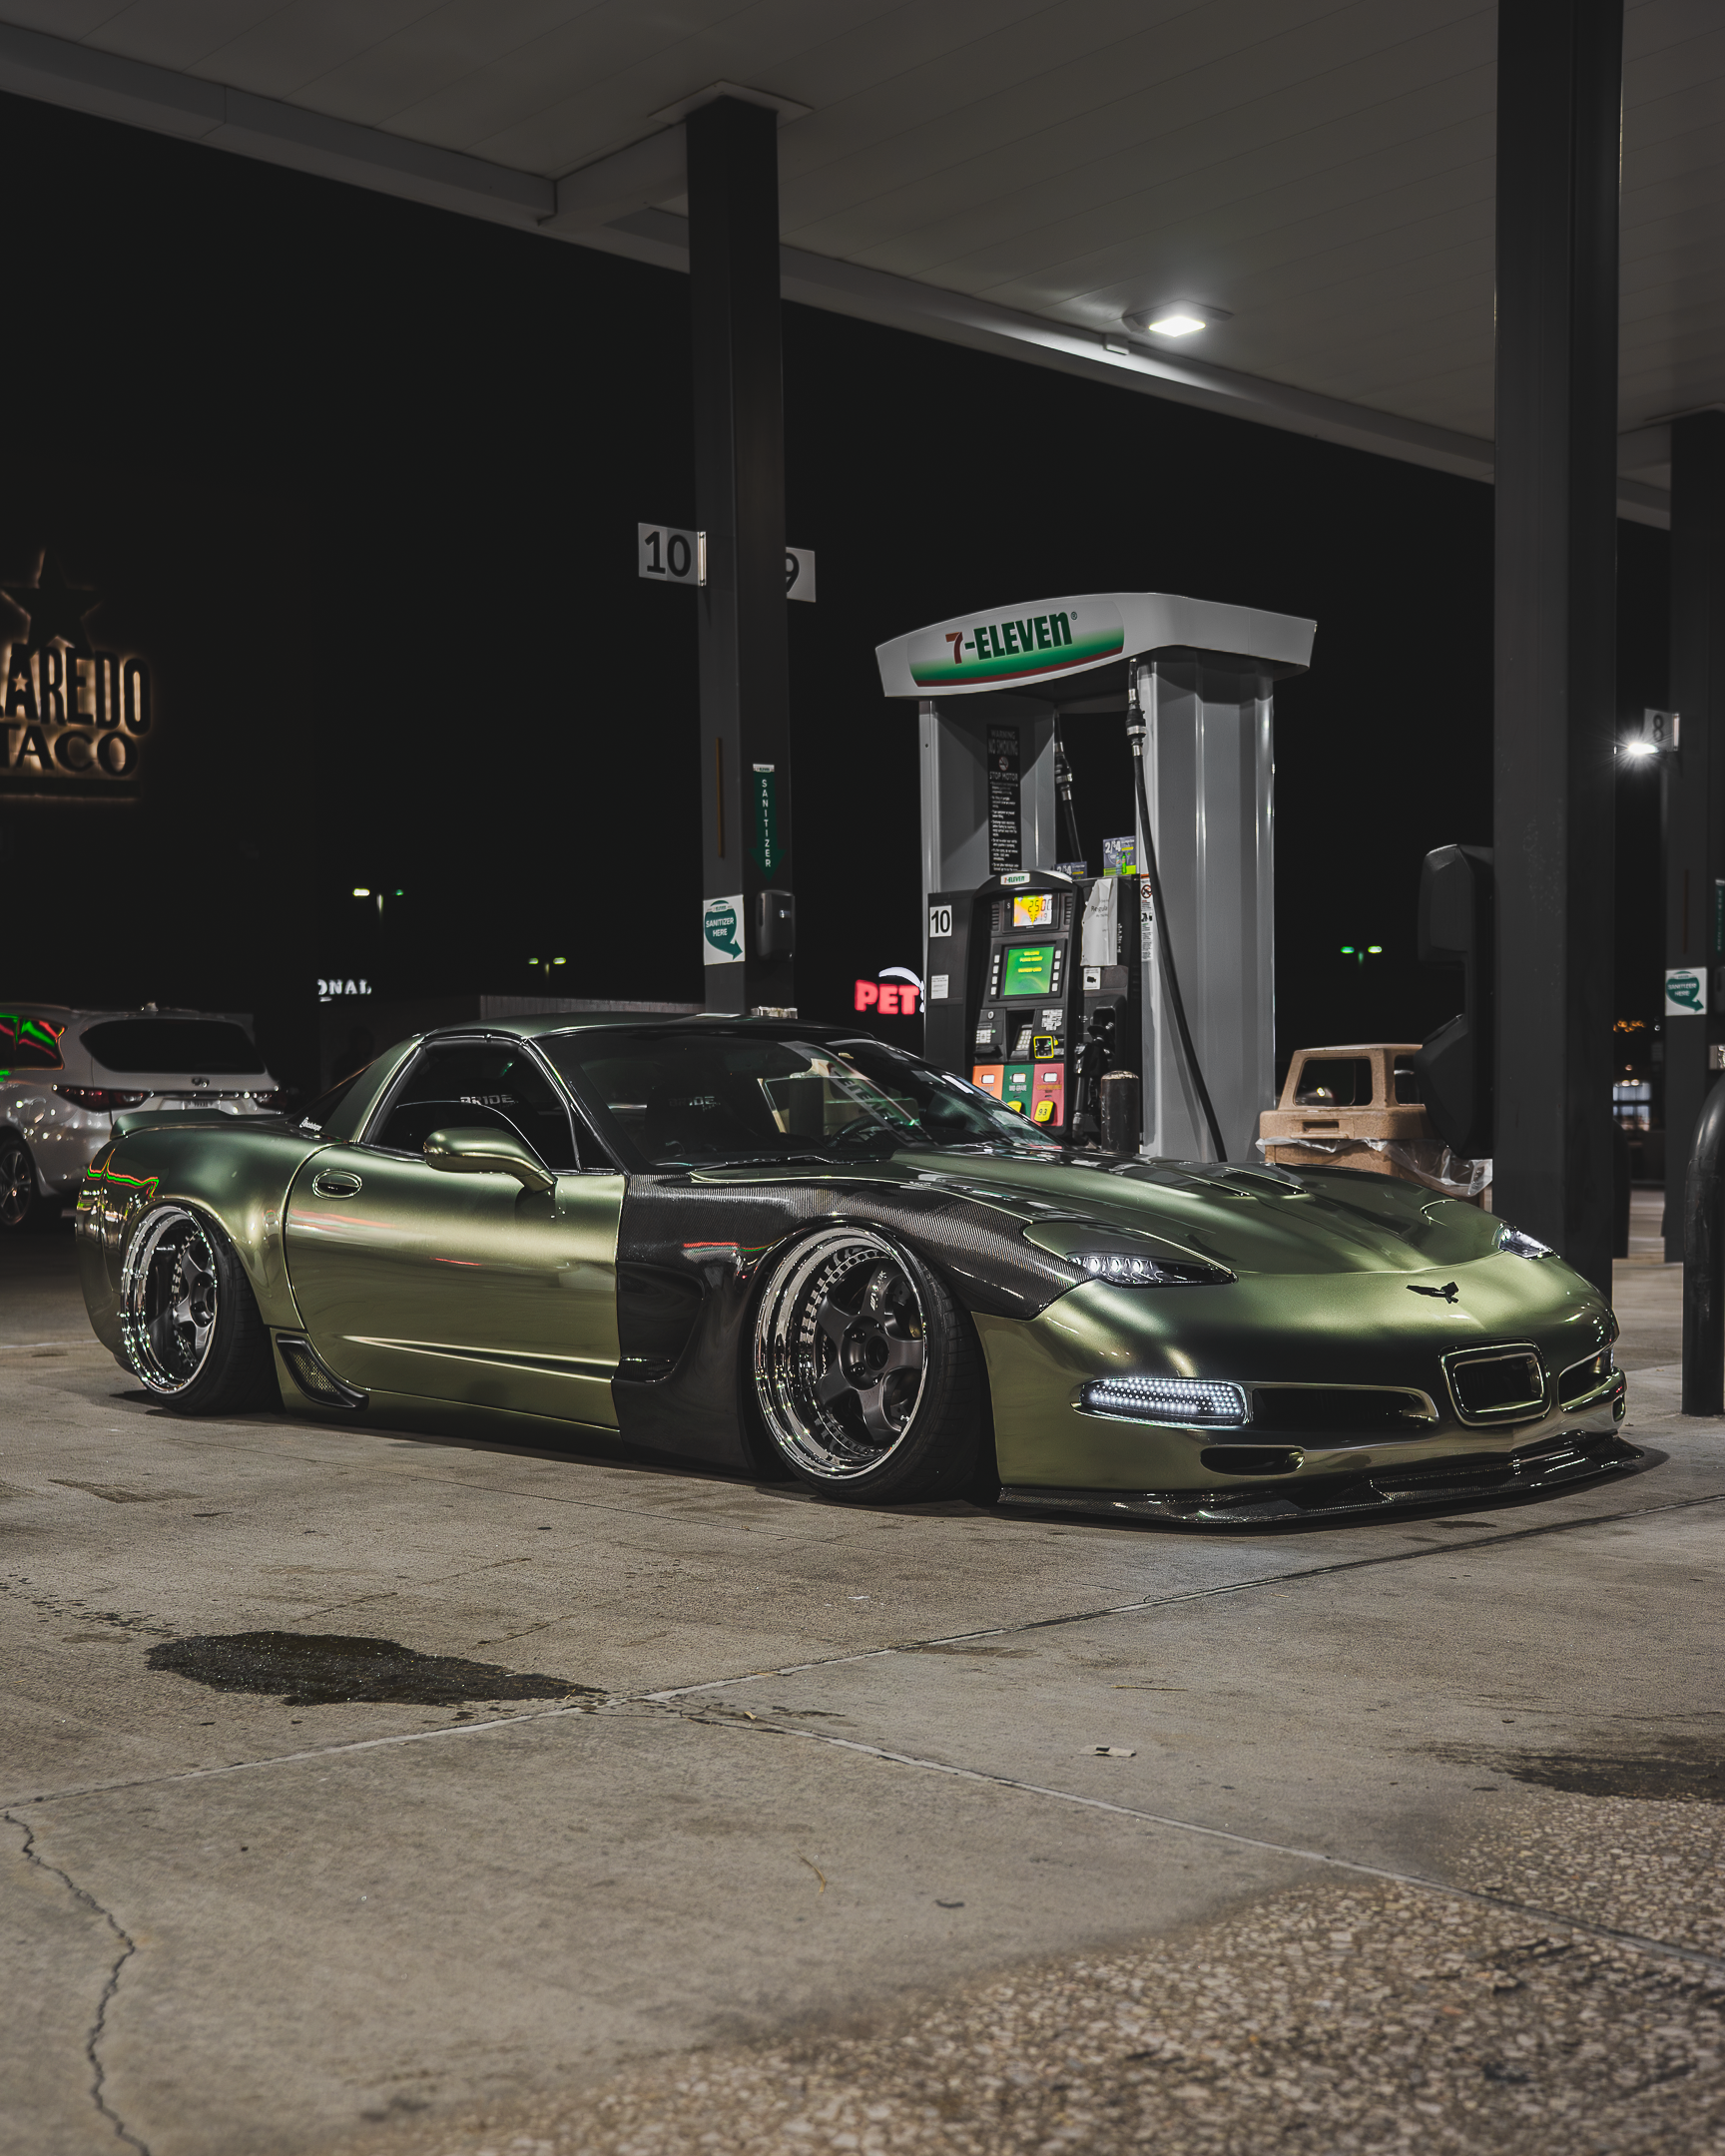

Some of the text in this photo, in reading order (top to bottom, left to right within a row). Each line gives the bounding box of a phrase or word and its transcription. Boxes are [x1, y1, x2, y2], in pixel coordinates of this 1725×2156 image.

[644, 531, 691, 578] 10
[0, 644, 151, 736] AREDO
[1653, 715, 1664, 743] 8
[762, 779, 773, 867] SANITIZER
[706, 917, 735, 928] SANITIZER
[713, 928, 728, 937] HERE
[930, 909, 951, 934] 10
[855, 979, 920, 1015] PET
